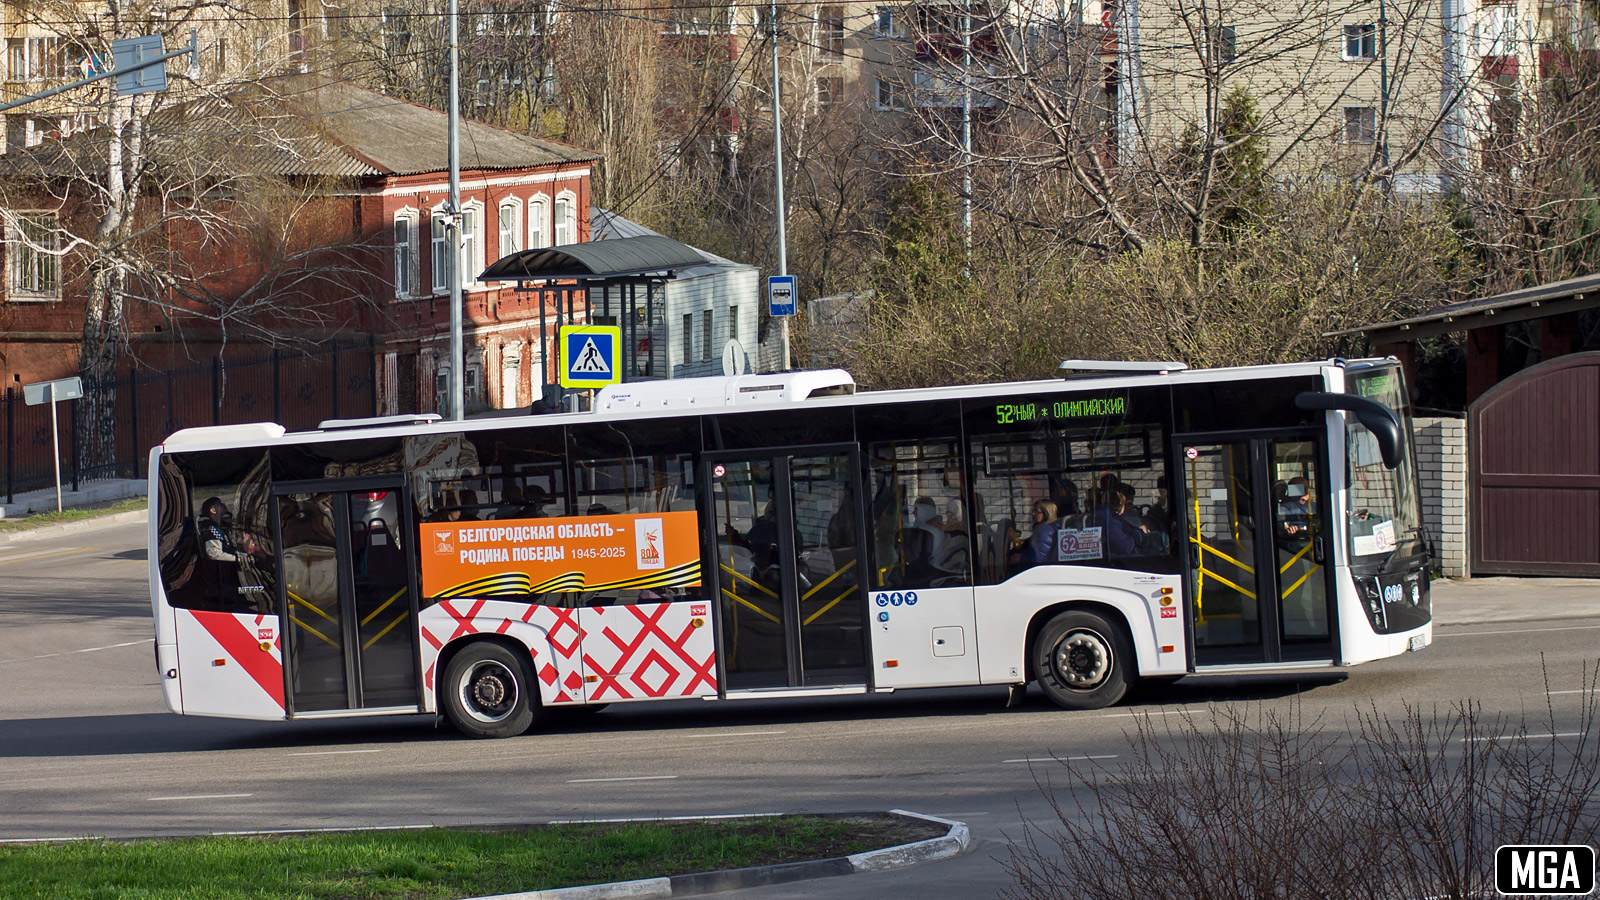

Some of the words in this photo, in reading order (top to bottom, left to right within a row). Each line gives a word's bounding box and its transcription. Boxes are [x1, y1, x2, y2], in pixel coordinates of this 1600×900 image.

[997, 405, 1014, 424] 52
[1053, 397, 1125, 419] ОЛИМПИЙСКИЙ
[459, 525, 554, 544] БЕЛГОРОДСКАЯ
[558, 522, 614, 539] ОБЛАСТЬ
[1062, 537, 1076, 551] 52
[460, 546, 510, 565] РОДИНА
[513, 545, 564, 563] ПОБЕДЫ
[571, 547, 626, 560] 1945-2025
[641, 549, 651, 558] 80
